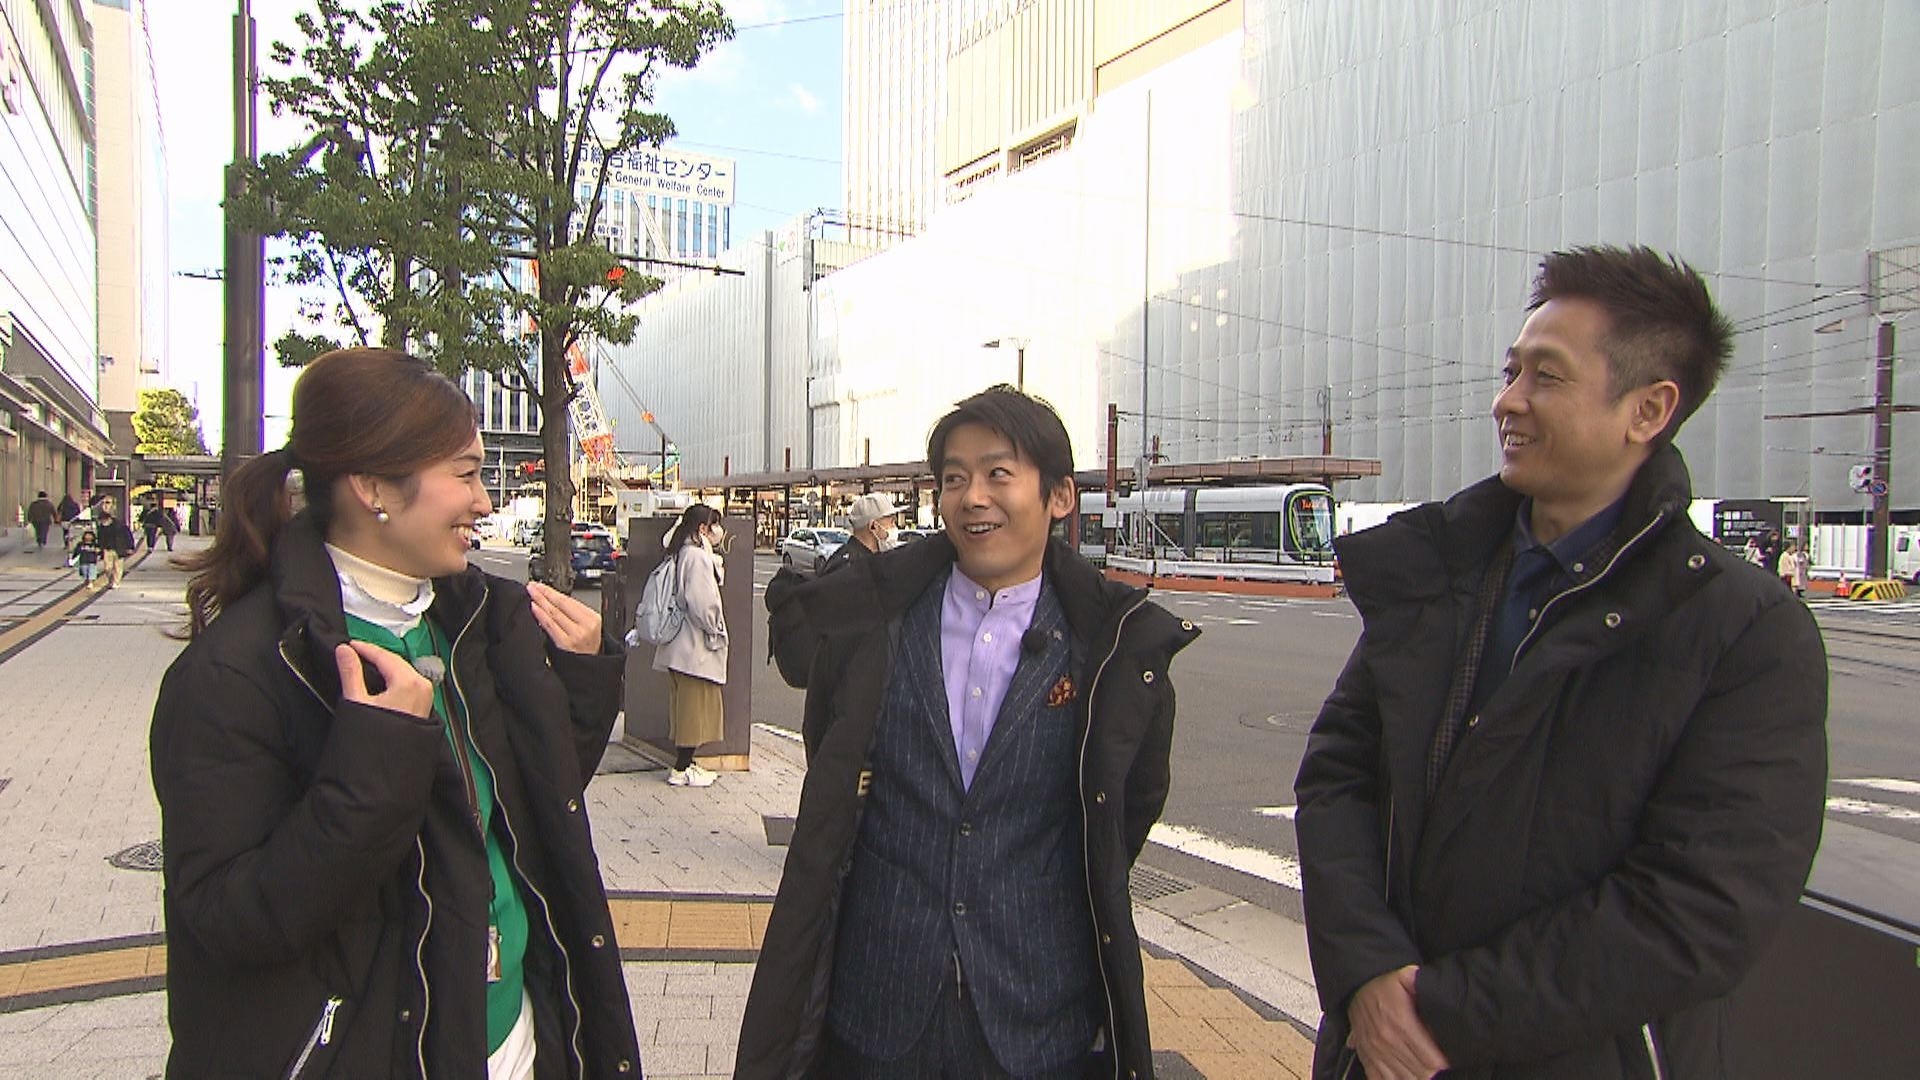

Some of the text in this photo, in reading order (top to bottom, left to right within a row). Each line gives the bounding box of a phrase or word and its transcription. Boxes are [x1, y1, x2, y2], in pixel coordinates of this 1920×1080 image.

[615, 171, 725, 199] General Welfare Center
